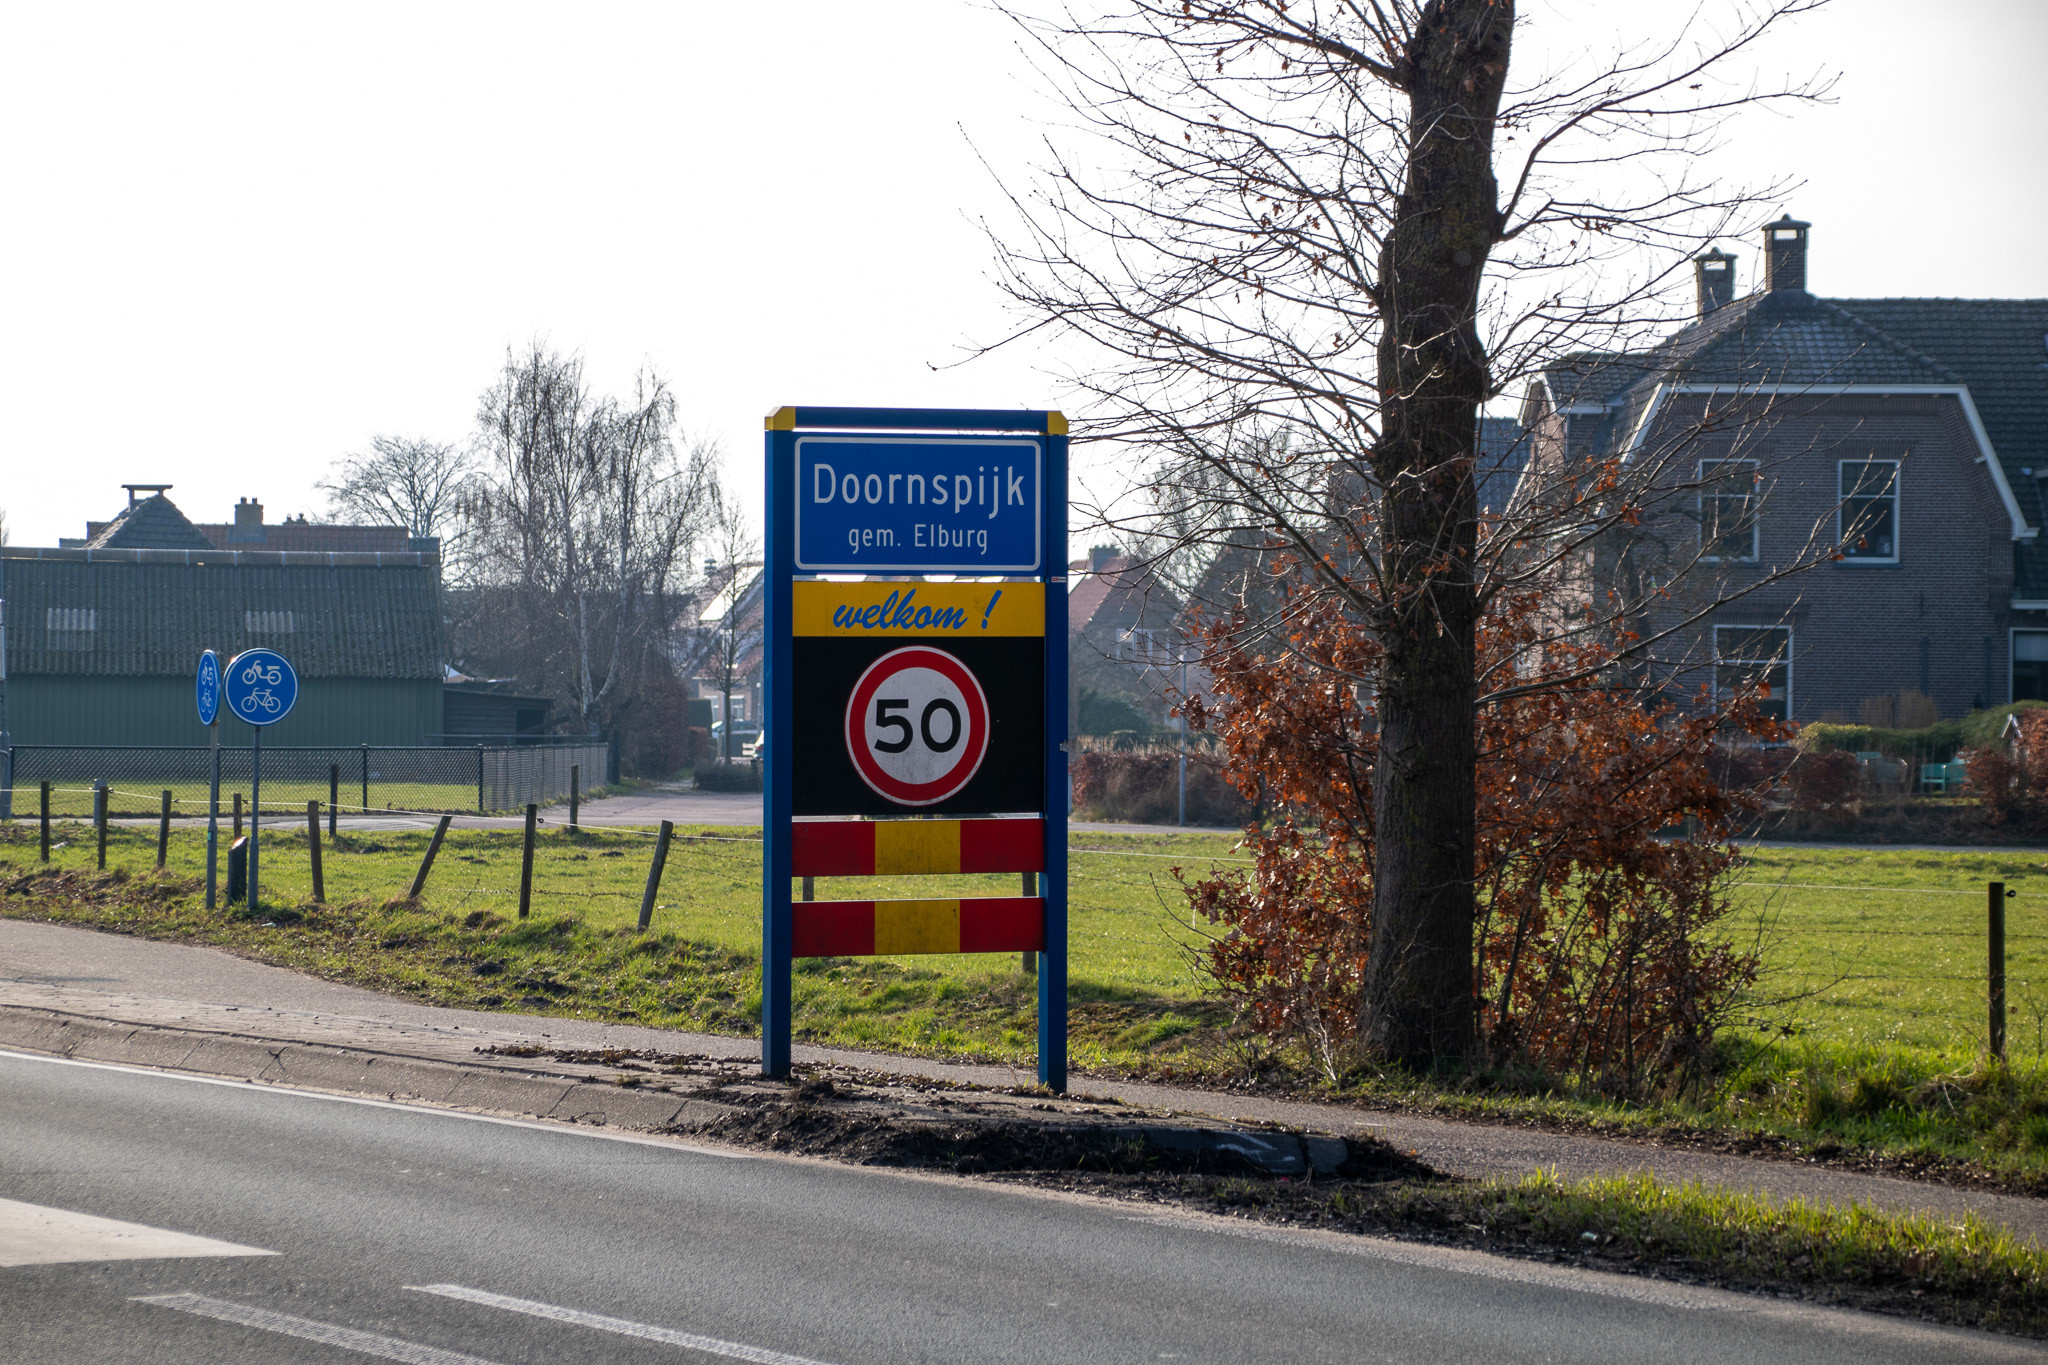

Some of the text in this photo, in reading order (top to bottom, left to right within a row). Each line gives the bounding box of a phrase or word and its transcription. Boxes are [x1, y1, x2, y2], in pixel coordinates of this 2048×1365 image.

[814, 463, 1025, 519] Doornspijk
[848, 523, 988, 556] gem. Elburg
[832, 588, 969, 630] welkom
[873, 697, 962, 754] 50
